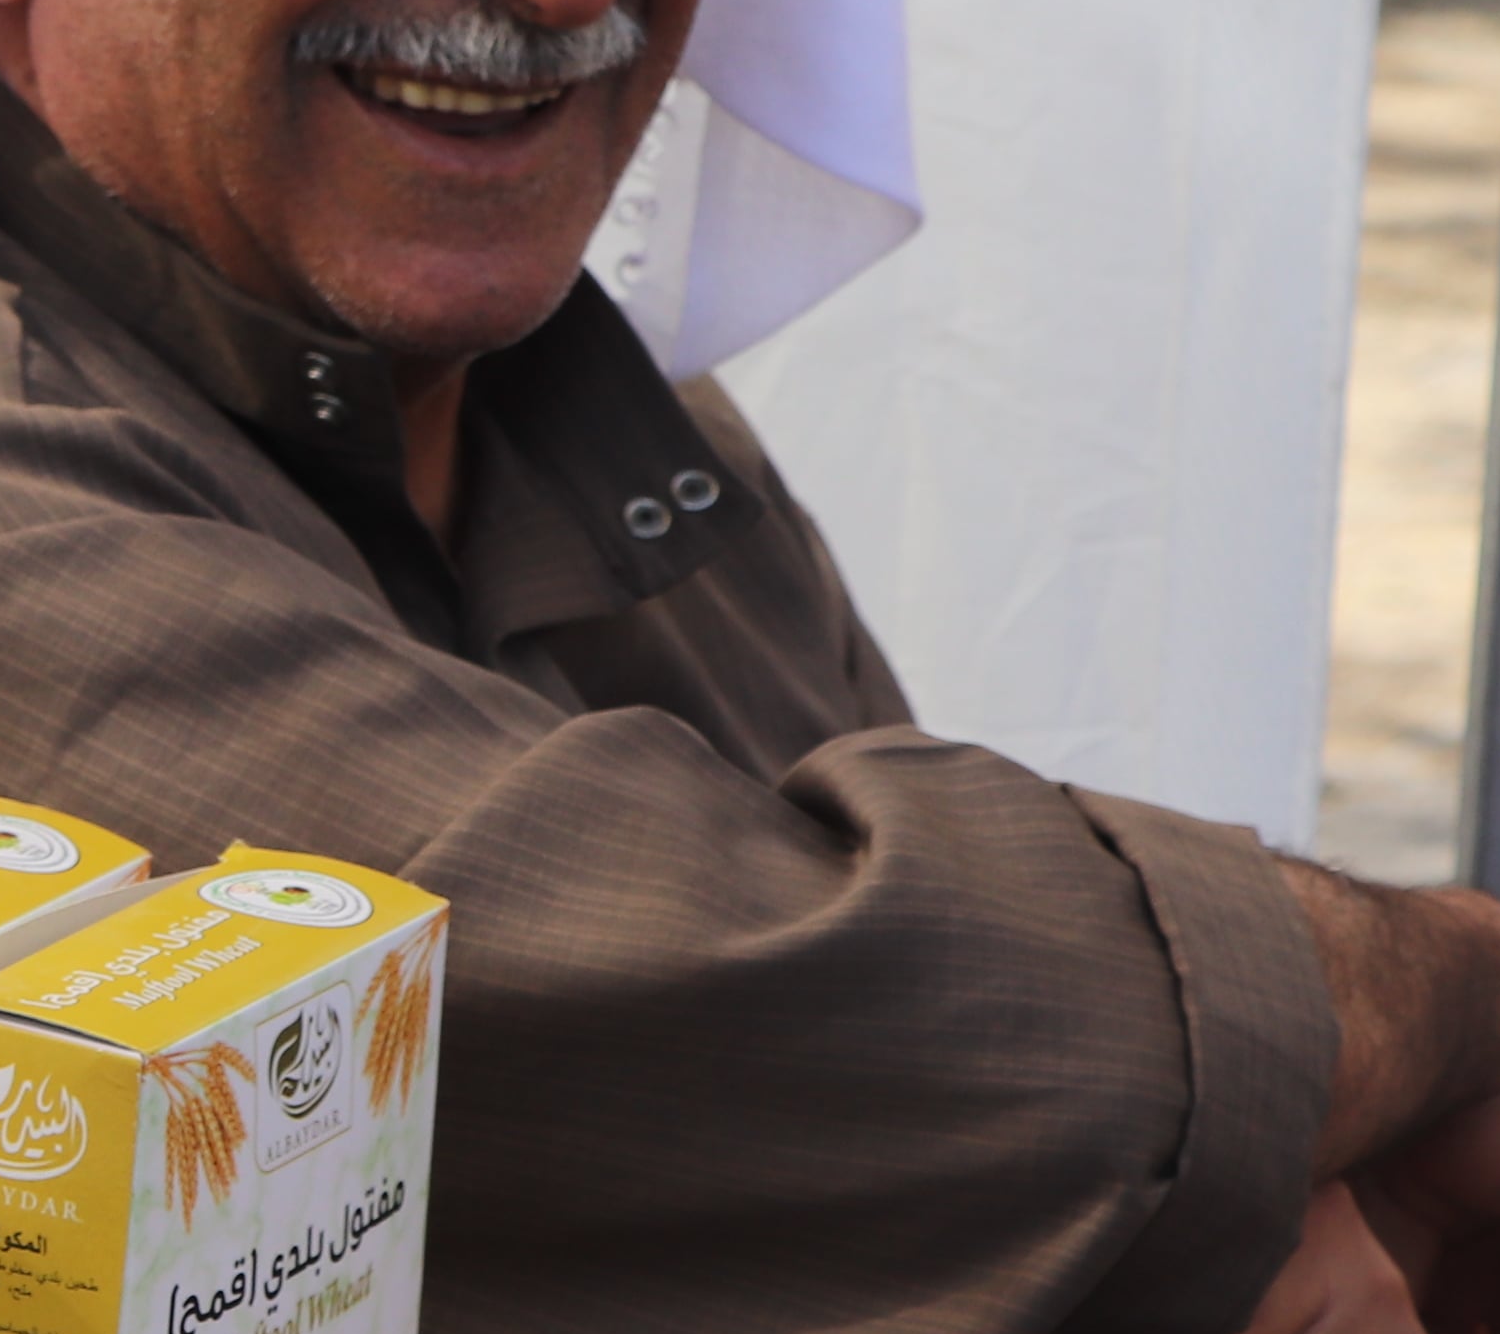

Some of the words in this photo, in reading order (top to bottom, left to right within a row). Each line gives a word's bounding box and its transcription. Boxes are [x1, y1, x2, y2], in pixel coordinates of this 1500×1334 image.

[112, 963, 202, 1010] Maftool
[187, 936, 262, 974] Wheat
[265, 1109, 342, 1165] ALBAYDAR
[330, 1177, 406, 1263] مفتول
[264, 1226, 325, 1317] بلدي
[308, 1262, 374, 1334] Wheat
